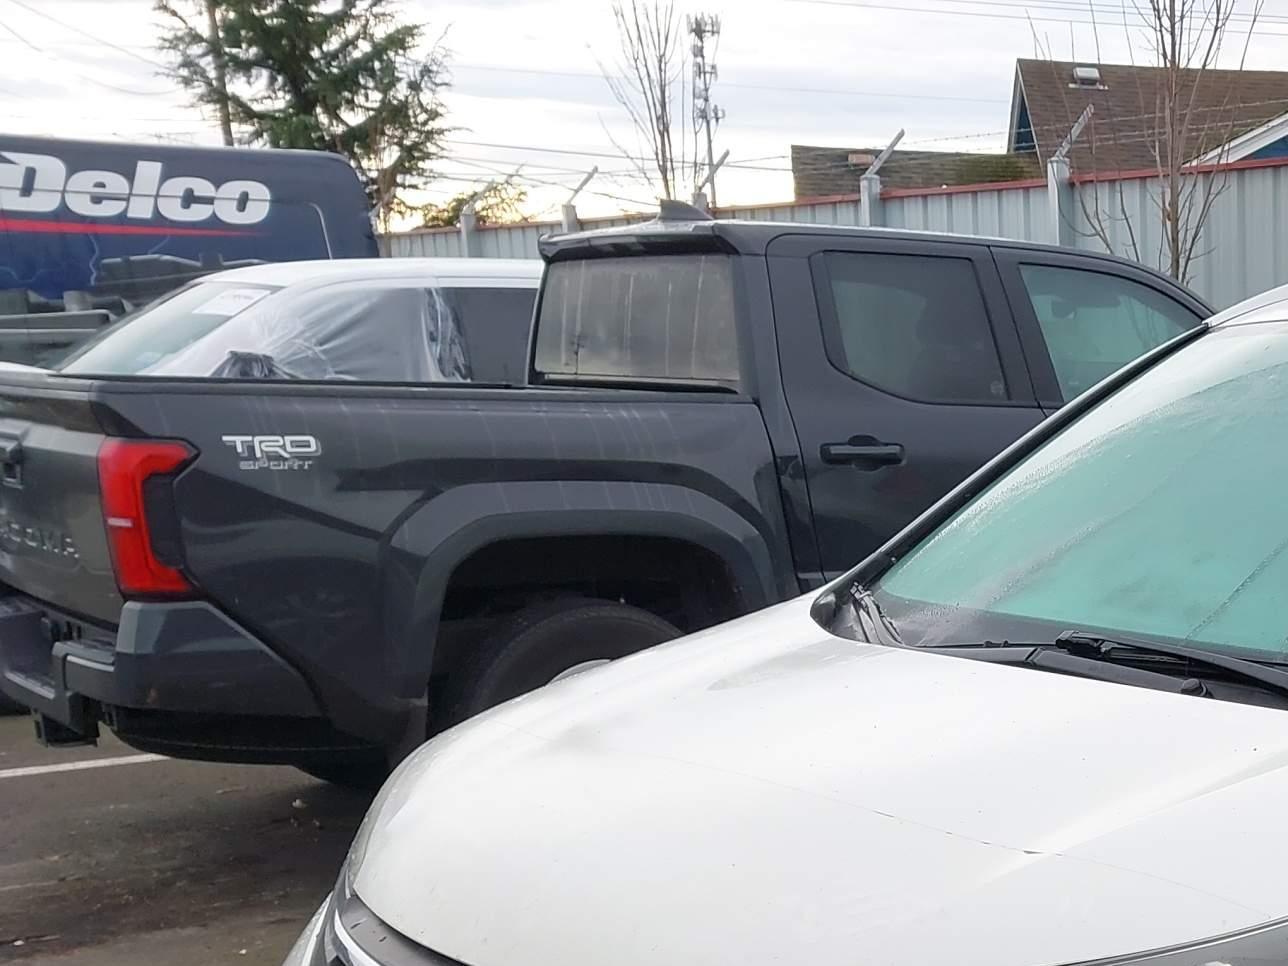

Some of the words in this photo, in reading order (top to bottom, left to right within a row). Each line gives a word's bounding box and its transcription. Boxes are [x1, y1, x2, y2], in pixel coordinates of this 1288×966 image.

[0, 151, 271, 224] Delco
[221, 435, 322, 458] TRD
[239, 459, 313, 470] SPORT
